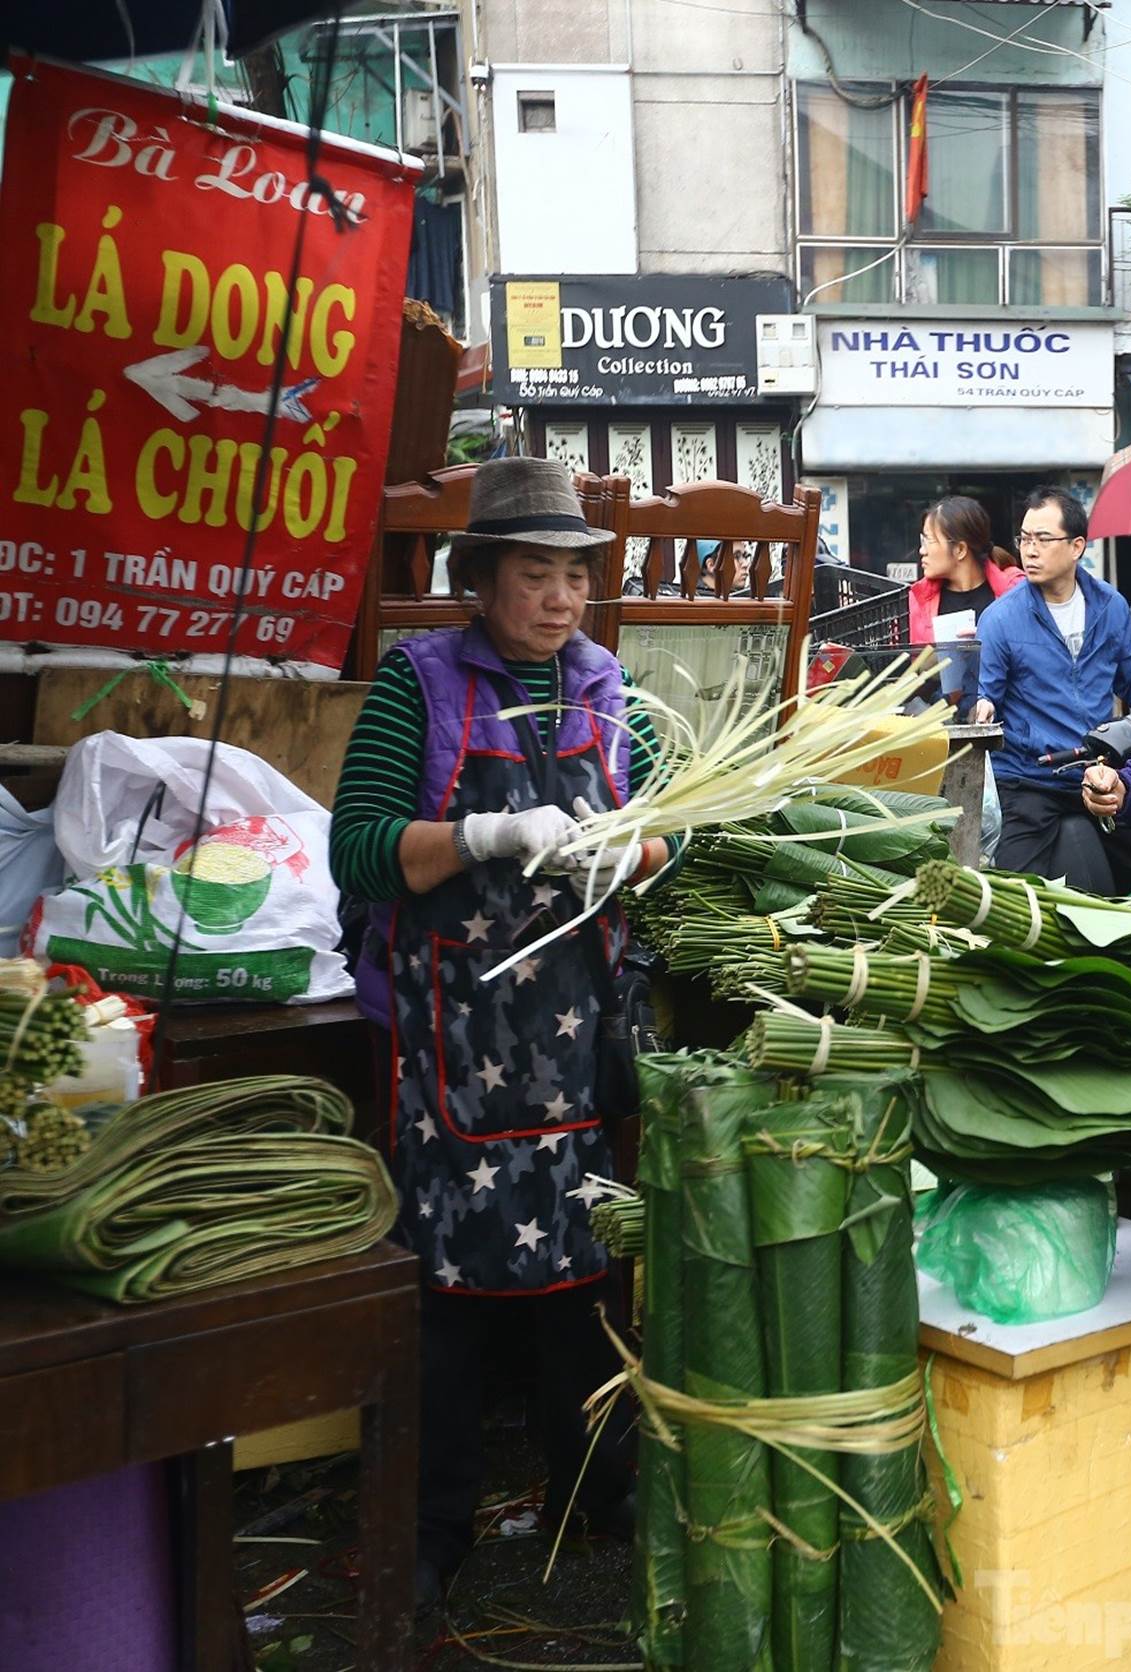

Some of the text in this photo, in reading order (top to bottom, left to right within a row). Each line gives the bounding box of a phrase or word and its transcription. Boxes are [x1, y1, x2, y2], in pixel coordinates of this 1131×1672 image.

[68, 108, 368, 224] Bà Loan
[30, 205, 356, 377] LÁ DONG
[561, 306, 726, 349] DƯƠNG
[831, 325, 1071, 353] NHÀ THUỐC
[597, 356, 693, 376] Collection
[870, 355, 1020, 380] THÁI SƠN
[13, 389, 358, 542] LÁ CHUỐI
[70, 549, 87, 578] 1
[104, 546, 197, 592] TRẦN
[208, 564, 276, 598] QUÝ
[282, 568, 345, 600] CÁP
[56, 597, 124, 631] 094
[137, 605, 180, 637] 77
[256, 616, 295, 643] 69
[97, 967, 273, 991] Trọng Lợng: 50 kg
